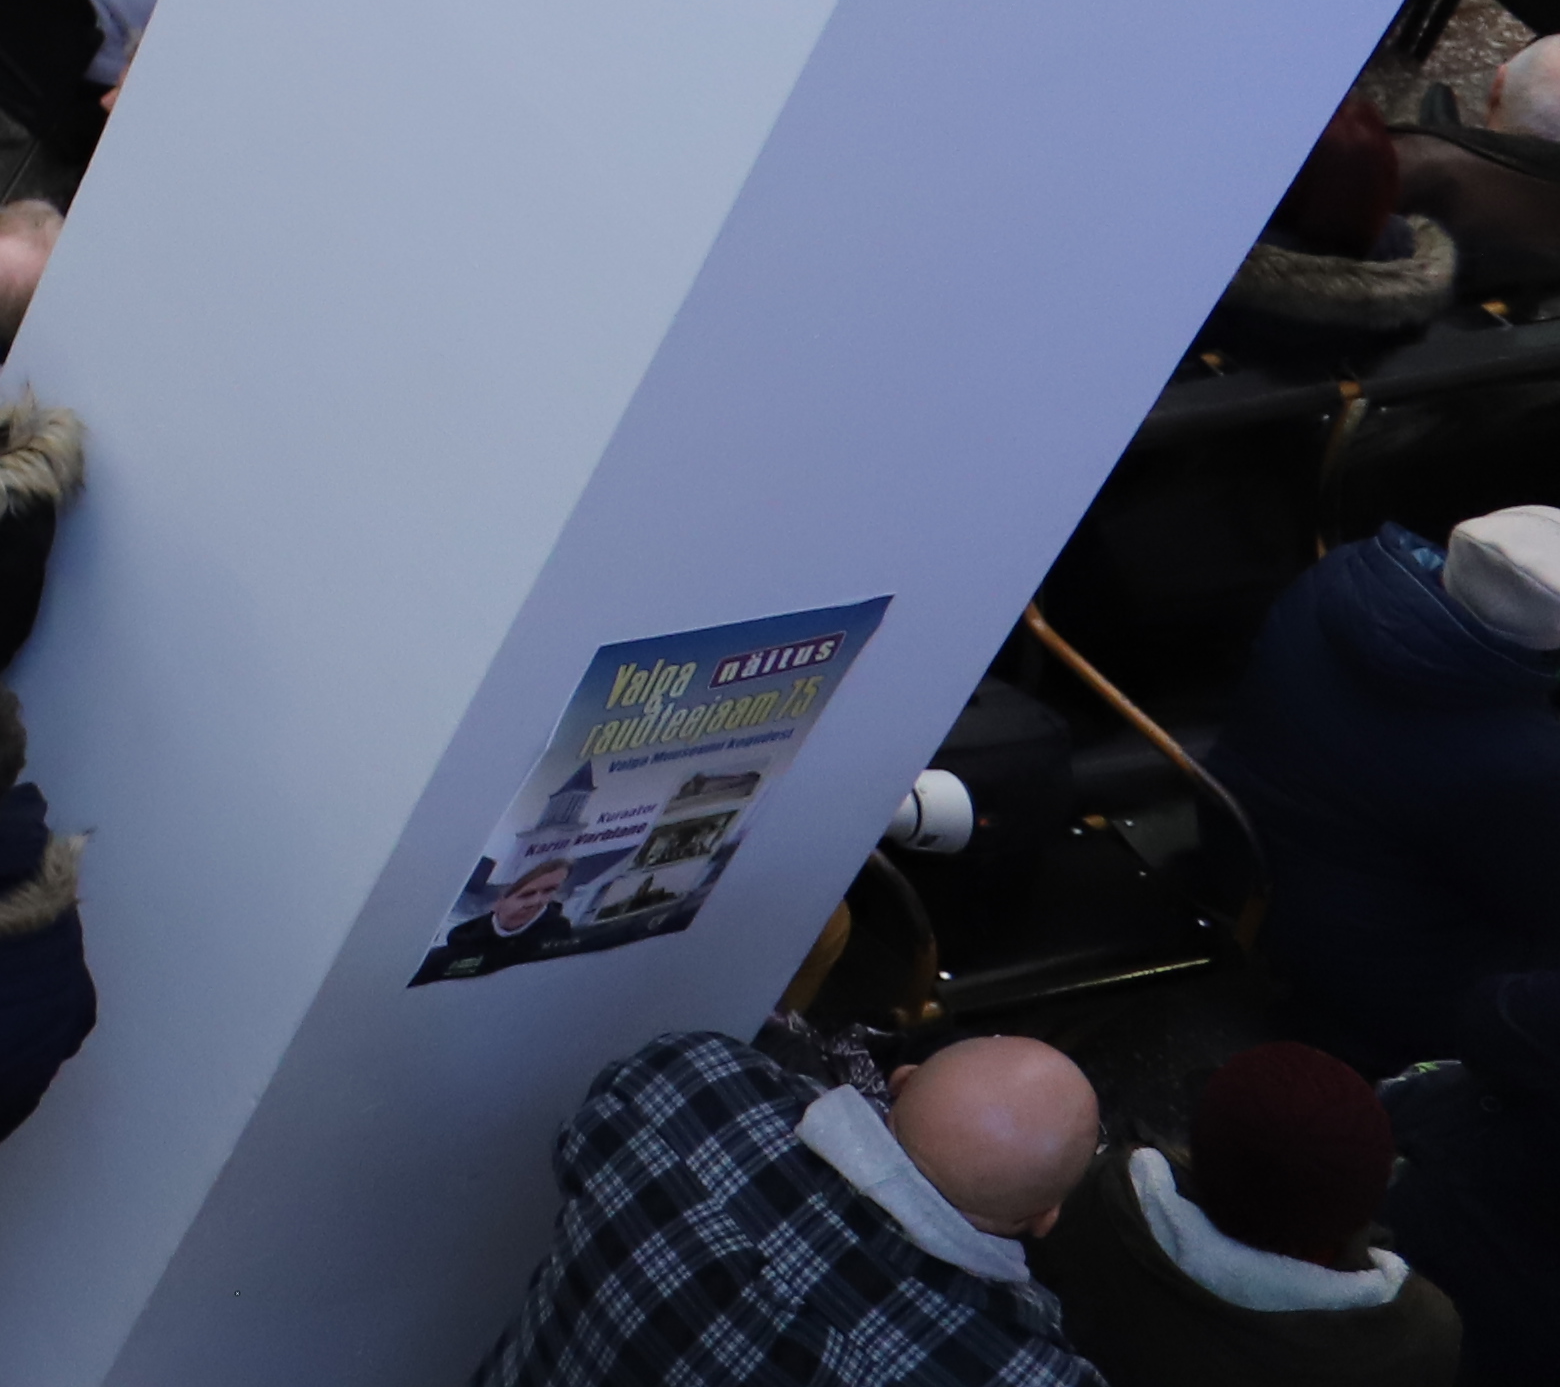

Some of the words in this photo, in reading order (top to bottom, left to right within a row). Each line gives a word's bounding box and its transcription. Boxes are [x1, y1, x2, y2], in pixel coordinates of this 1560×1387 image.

[719, 635, 837, 684] näitus
[604, 658, 697, 714] Valga
[579, 690, 778, 759] raudteejaam
[775, 675, 824, 721] 75
[597, 800, 658, 825] Kuraator
[524, 837, 569, 859] Karin
